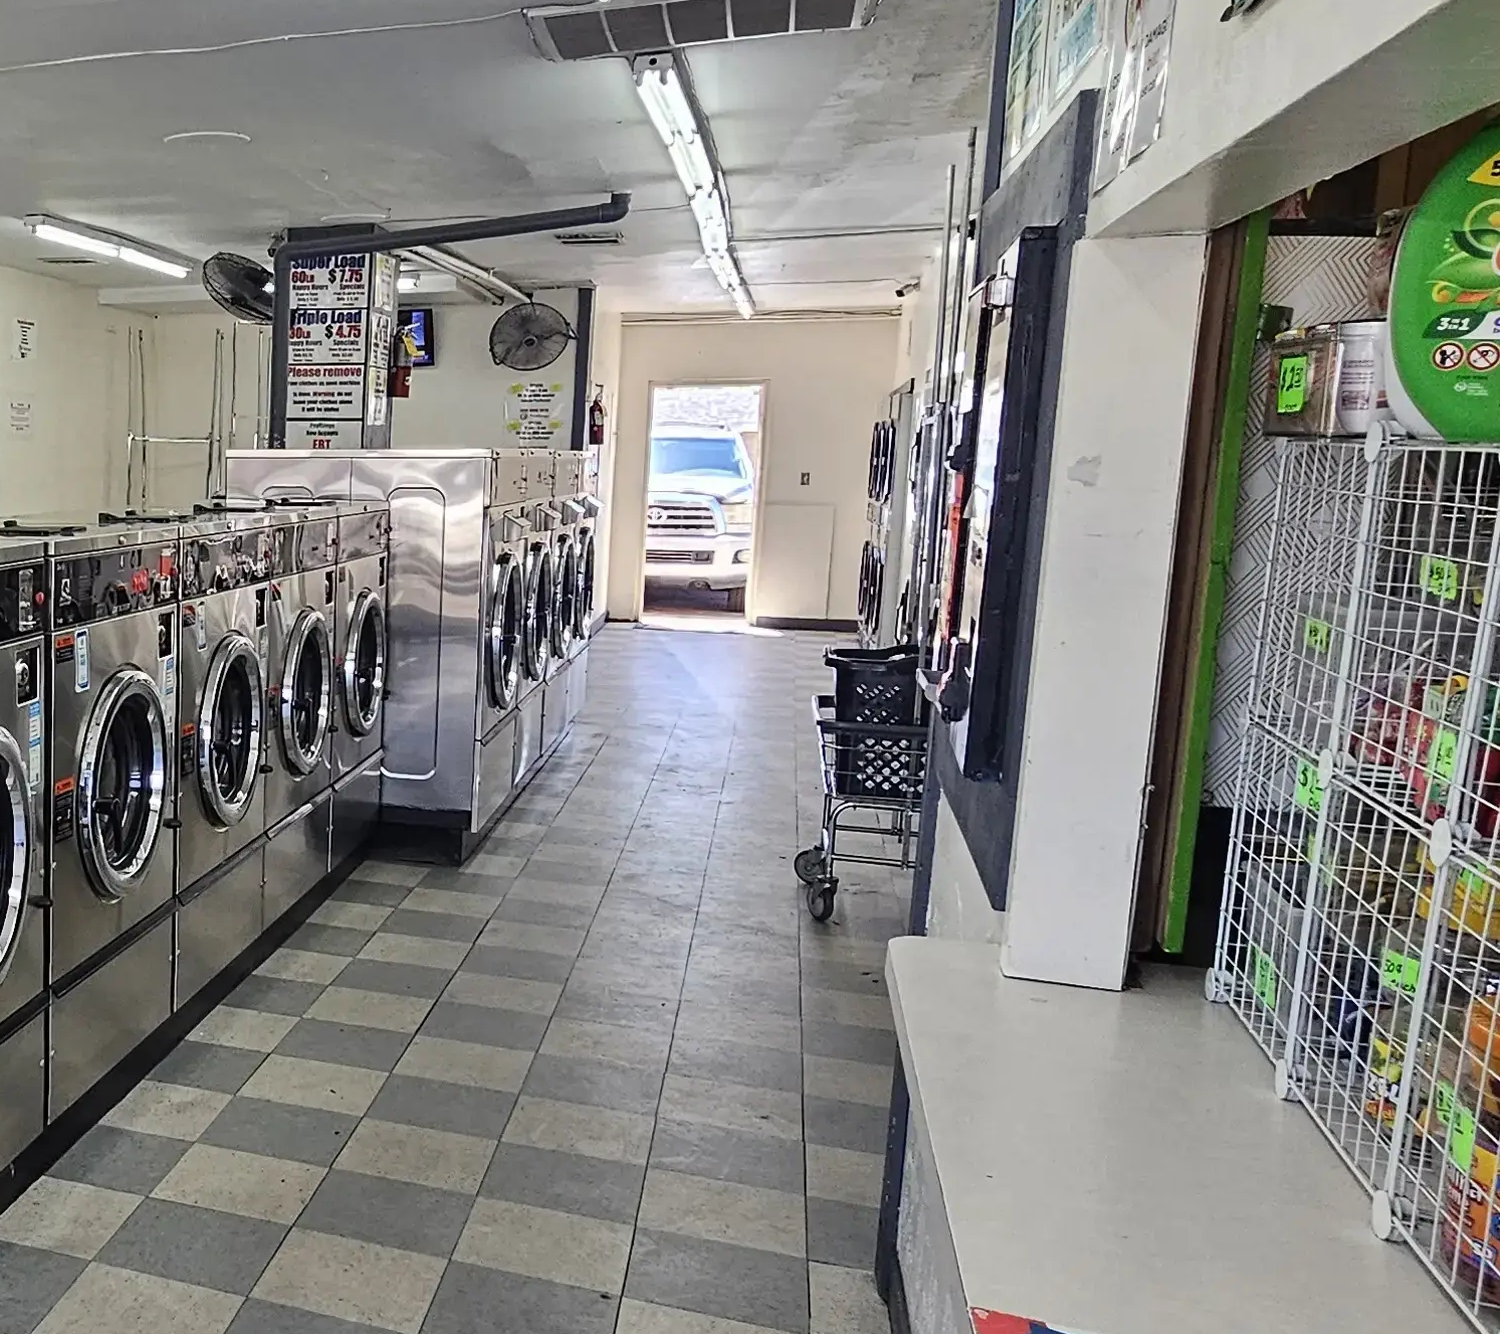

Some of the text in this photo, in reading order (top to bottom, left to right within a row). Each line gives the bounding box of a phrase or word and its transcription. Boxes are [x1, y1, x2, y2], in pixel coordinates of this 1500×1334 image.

[334, 254, 365, 268] Load
[339, 269, 363, 283] 7.75
[330, 310, 361, 324] Load
[336, 325, 361, 339] 4.75
[288, 367, 361, 378] Please remove
